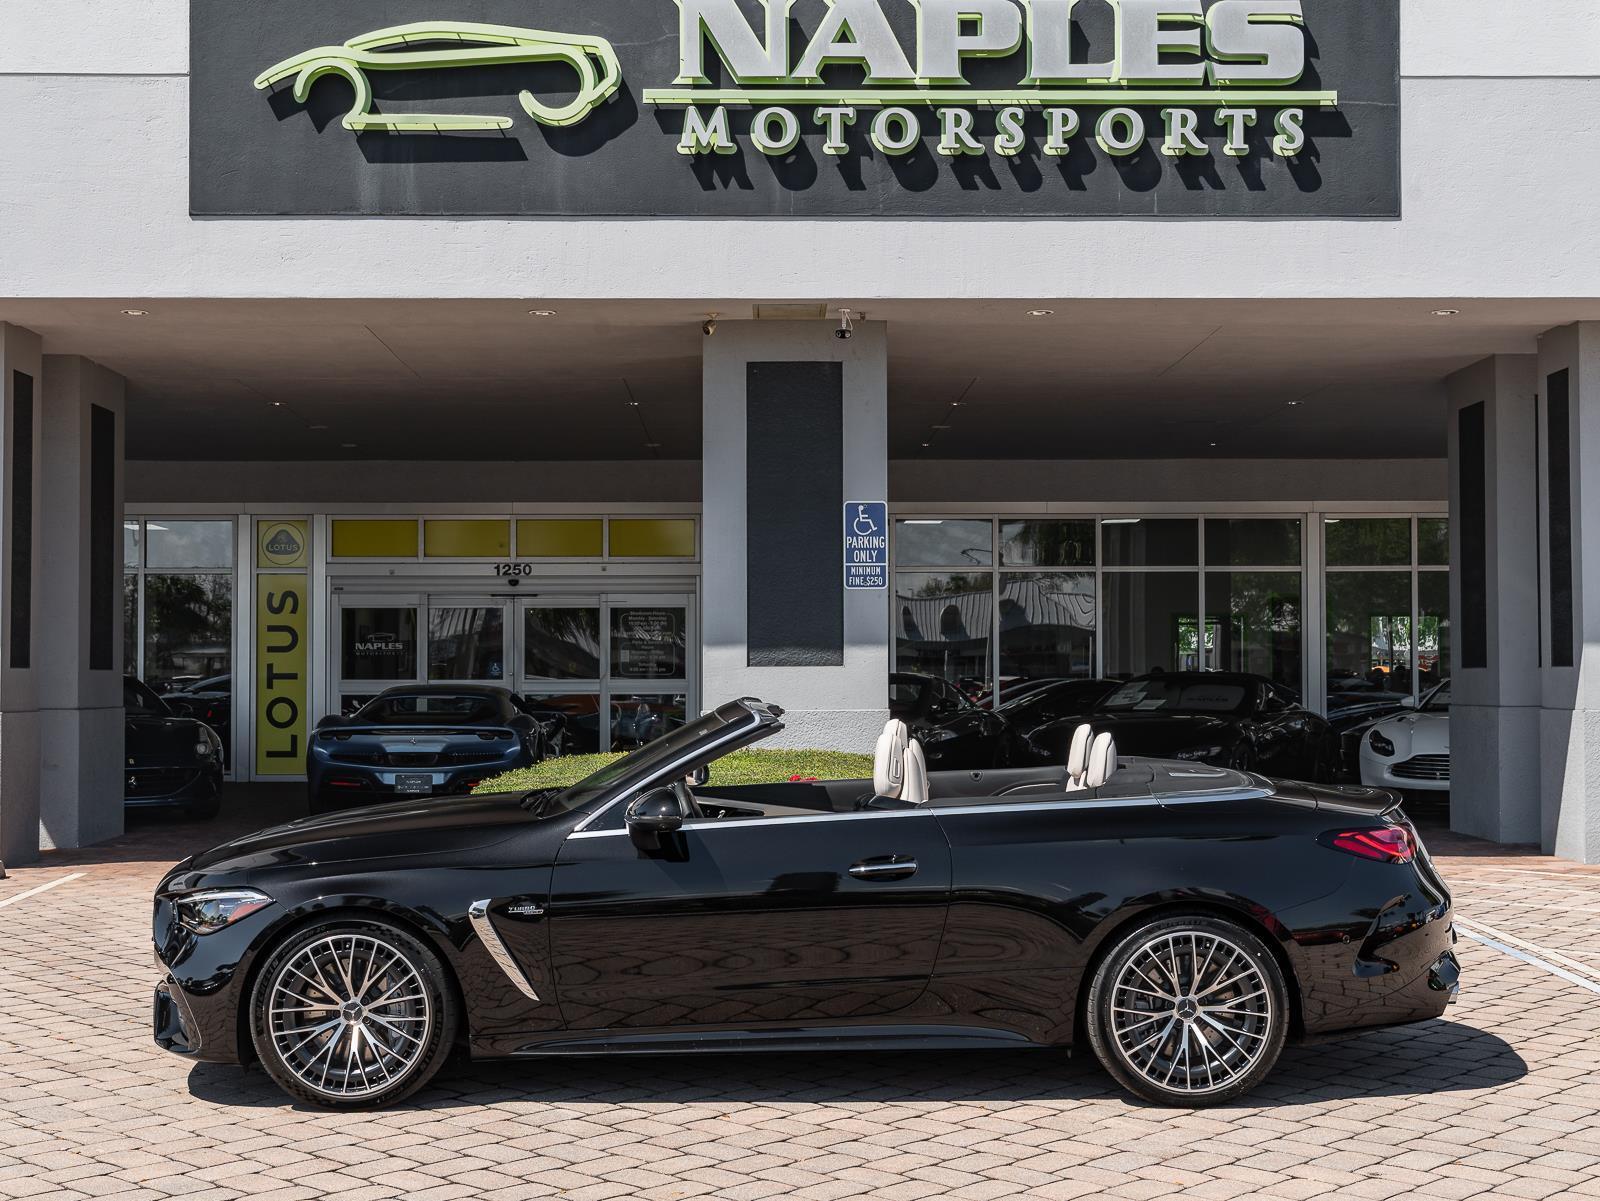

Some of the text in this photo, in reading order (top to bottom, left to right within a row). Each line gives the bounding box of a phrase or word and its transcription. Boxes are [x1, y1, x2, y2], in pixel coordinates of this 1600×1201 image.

[672, 0, 1304, 86] NAPLES
[677, 104, 1305, 156] MOTORSPORTS
[268, 543, 298, 551] LOTUS
[846, 536, 885, 549] PARKING
[853, 550, 878, 562] ONLY
[493, 563, 533, 576] 1250
[850, 566, 881, 575] MINIMUM
[848, 576, 883, 586] FINE $250
[355, 642, 403, 650] NAPLES
[266, 589, 300, 758] LOTUS
